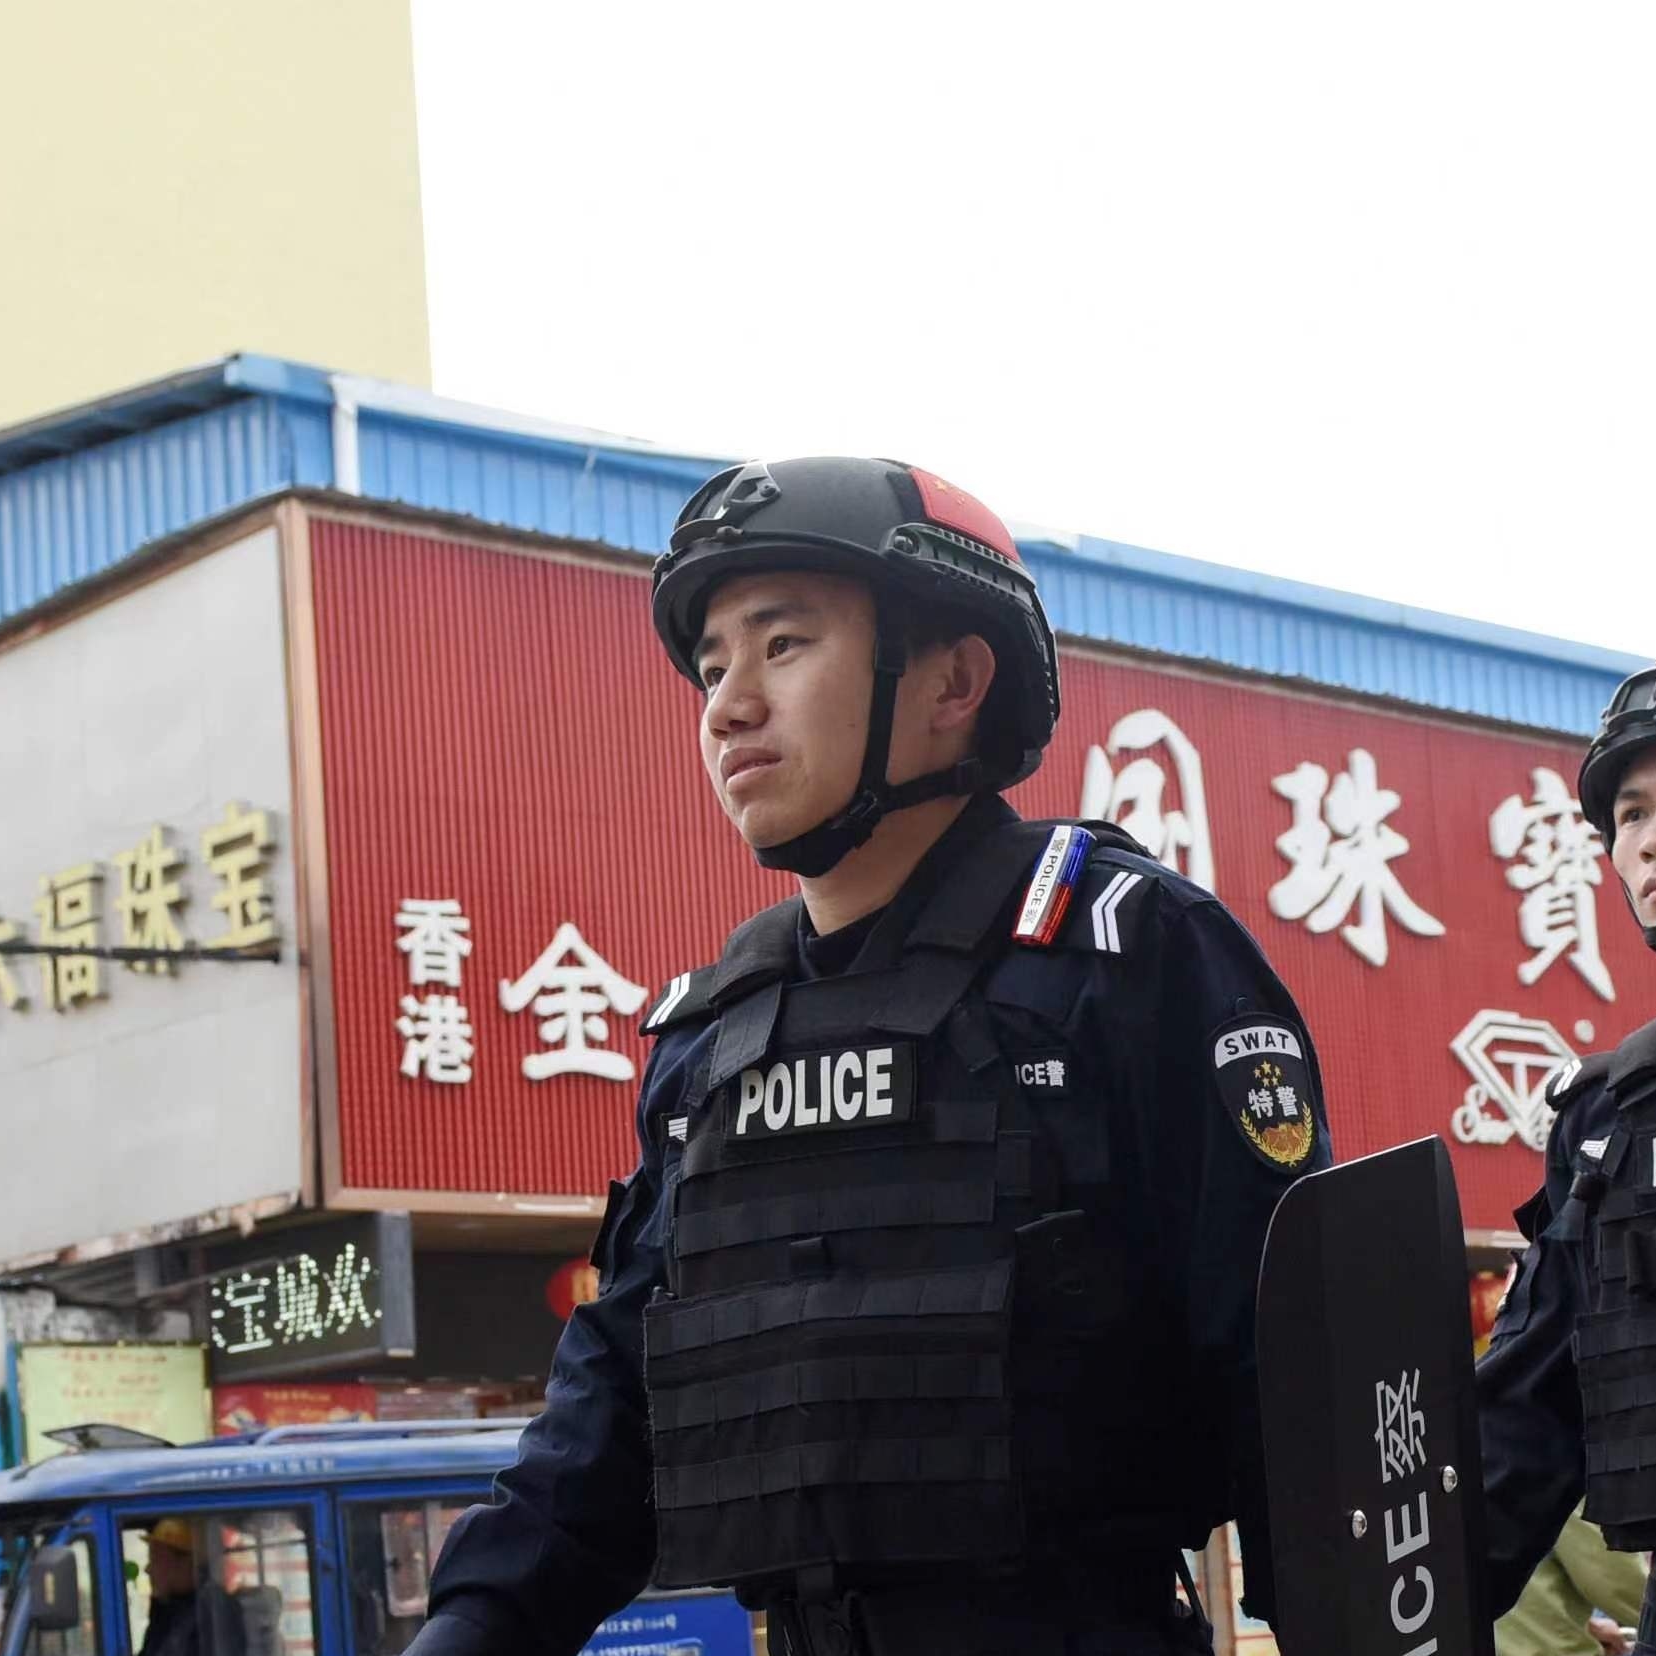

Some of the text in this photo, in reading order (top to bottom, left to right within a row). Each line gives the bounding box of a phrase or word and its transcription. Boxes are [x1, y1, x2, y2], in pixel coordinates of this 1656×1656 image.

[1030, 854, 1059, 907] POLICE
[395, 898, 475, 1084] 香港
[1223, 1031, 1290, 1056] SWAT
[735, 1047, 894, 1136] POLICE
[1247, 1085, 1298, 1119] 特警
[211, 1242, 384, 1354] 宝城欢
[1374, 1367, 1427, 1484] 察
